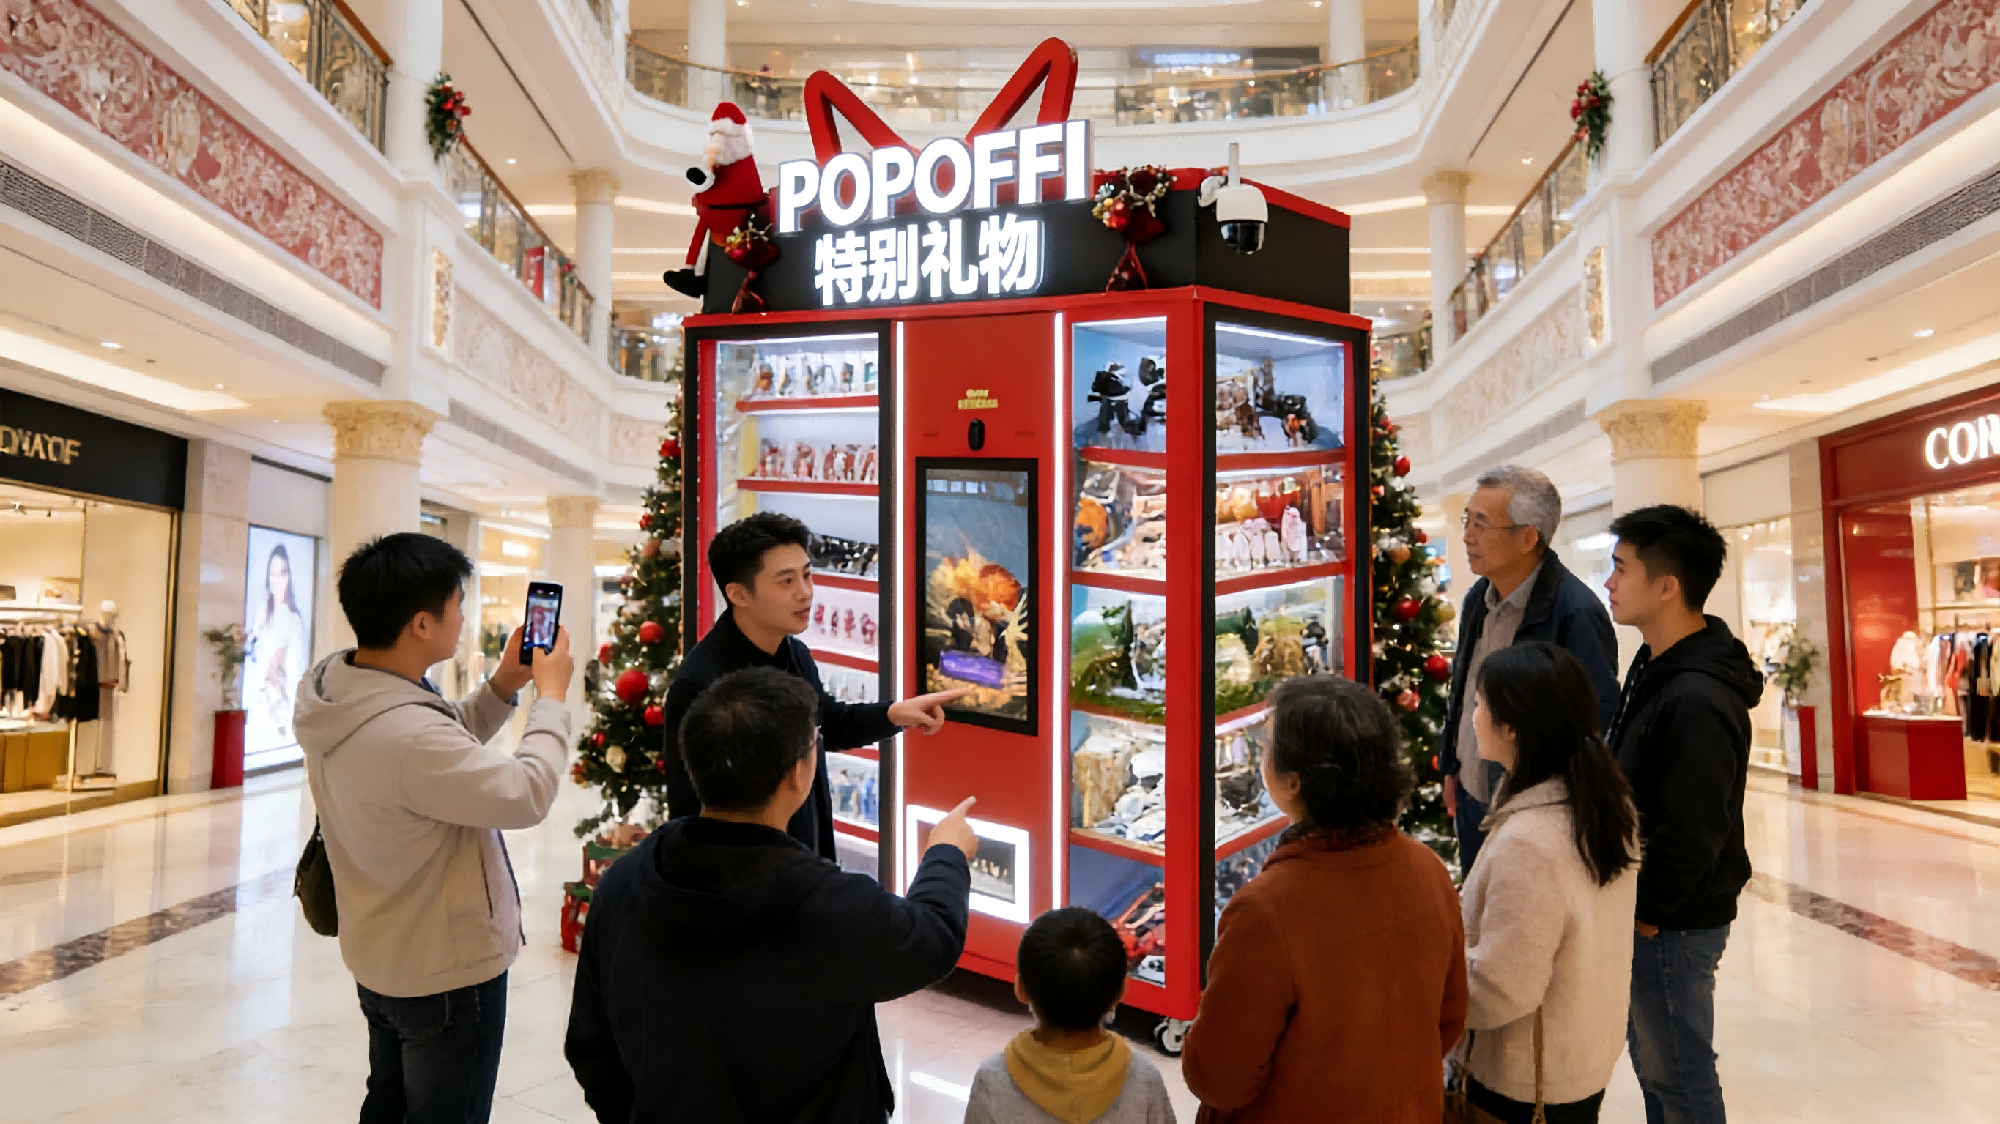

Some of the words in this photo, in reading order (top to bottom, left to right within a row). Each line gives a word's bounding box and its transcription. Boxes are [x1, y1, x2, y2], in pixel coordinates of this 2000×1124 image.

[778, 119, 1090, 235] POPOFFI
[815, 213, 1045, 307] 特别礼物
